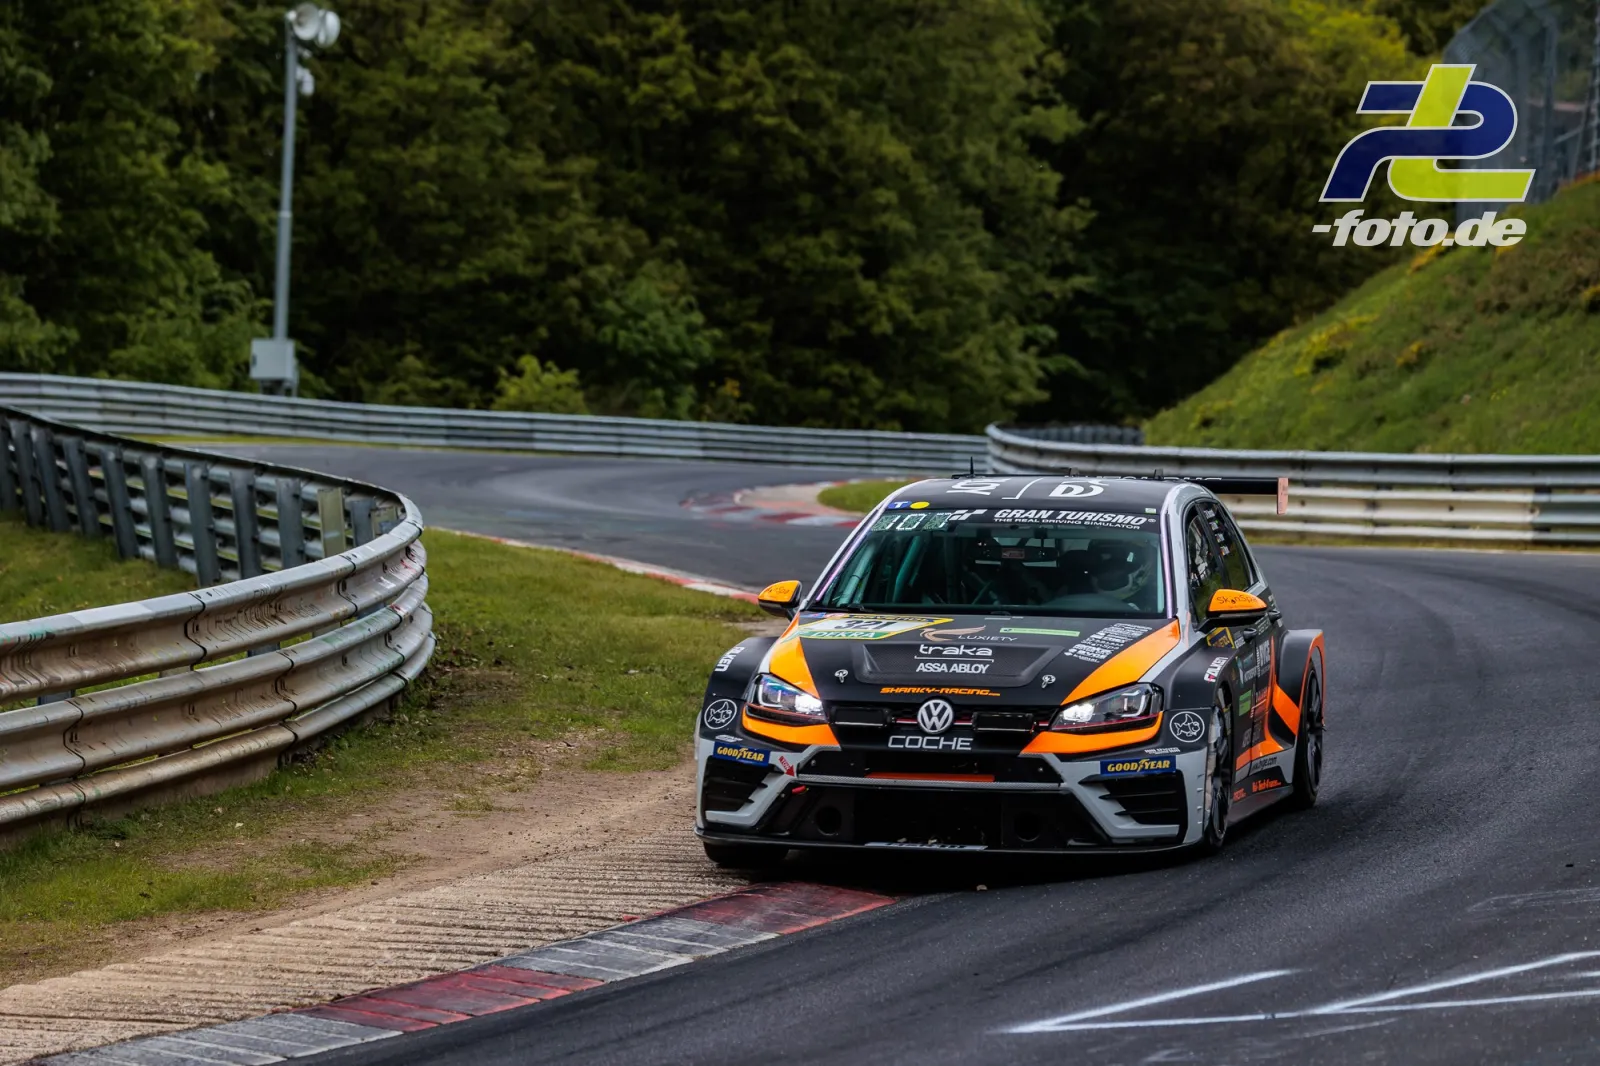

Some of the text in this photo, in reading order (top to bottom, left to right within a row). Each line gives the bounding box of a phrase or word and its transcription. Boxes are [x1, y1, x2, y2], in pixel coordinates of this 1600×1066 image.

[994, 509, 1053, 518] GRAN
[1057, 510, 1147, 525] TURISMO
[1084, 521, 1140, 530] SIMULATOR
[835, 619, 897, 630] 321
[919, 644, 992, 656] traka
[916, 662, 990, 674] ASSA ABLOY
[888, 735, 974, 750] COCHE
[716, 746, 765, 761] GOODYEAR
[1107, 758, 1171, 772] GOODYEAR
